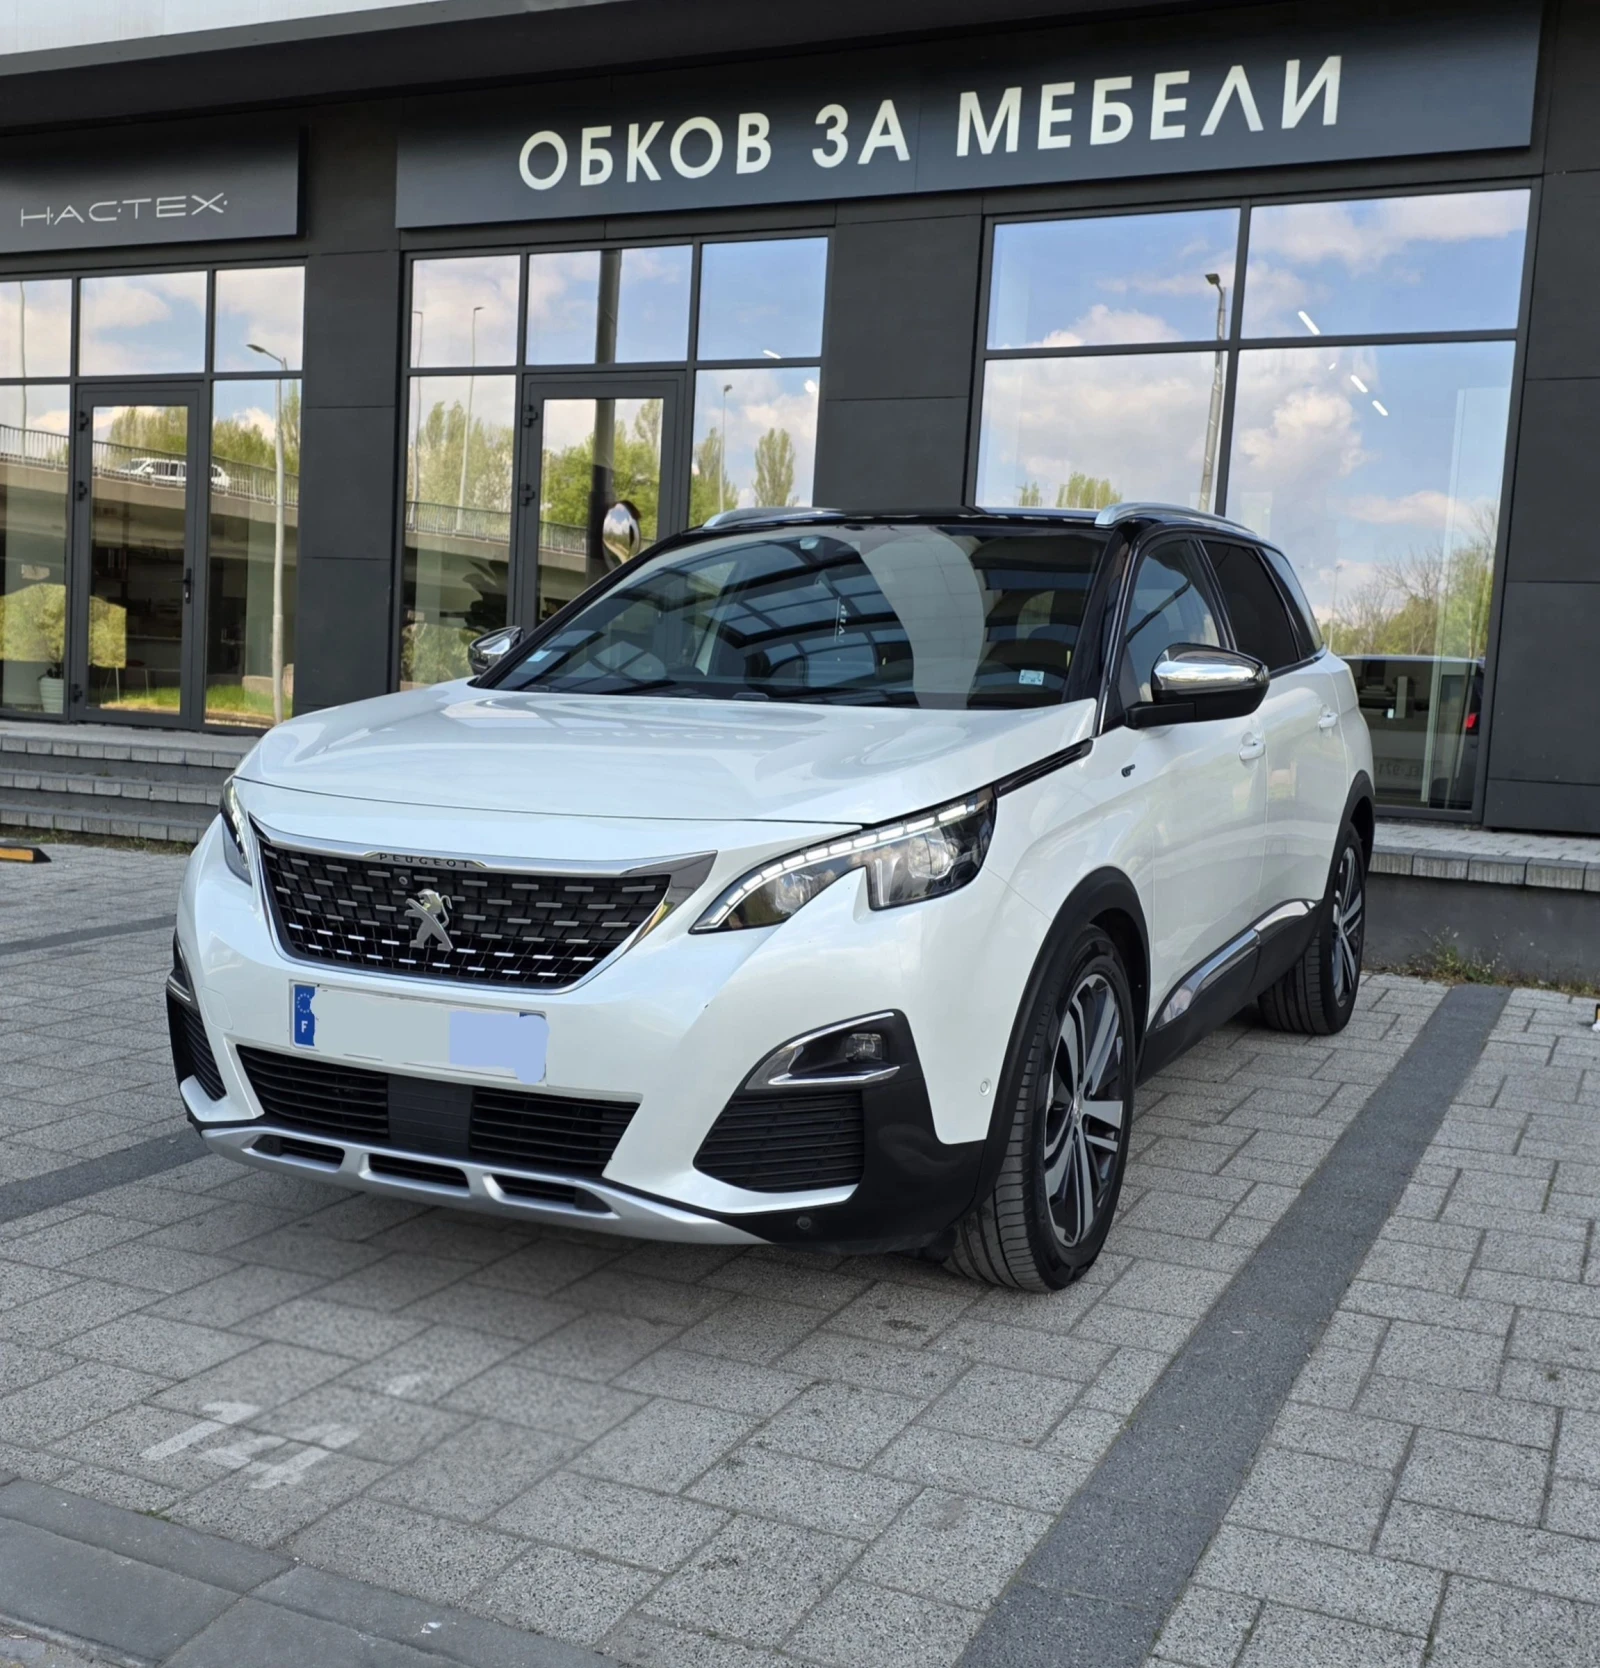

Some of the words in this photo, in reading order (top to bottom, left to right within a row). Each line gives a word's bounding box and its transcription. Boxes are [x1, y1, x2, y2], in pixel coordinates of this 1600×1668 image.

[517, 111, 773, 191] ОБКОВ
[811, 99, 912, 169] ЗА
[955, 55, 1343, 157] МЕБЕЛИ
[379, 852, 470, 869] PEUGEOT
[300, 1020, 309, 1033] F
